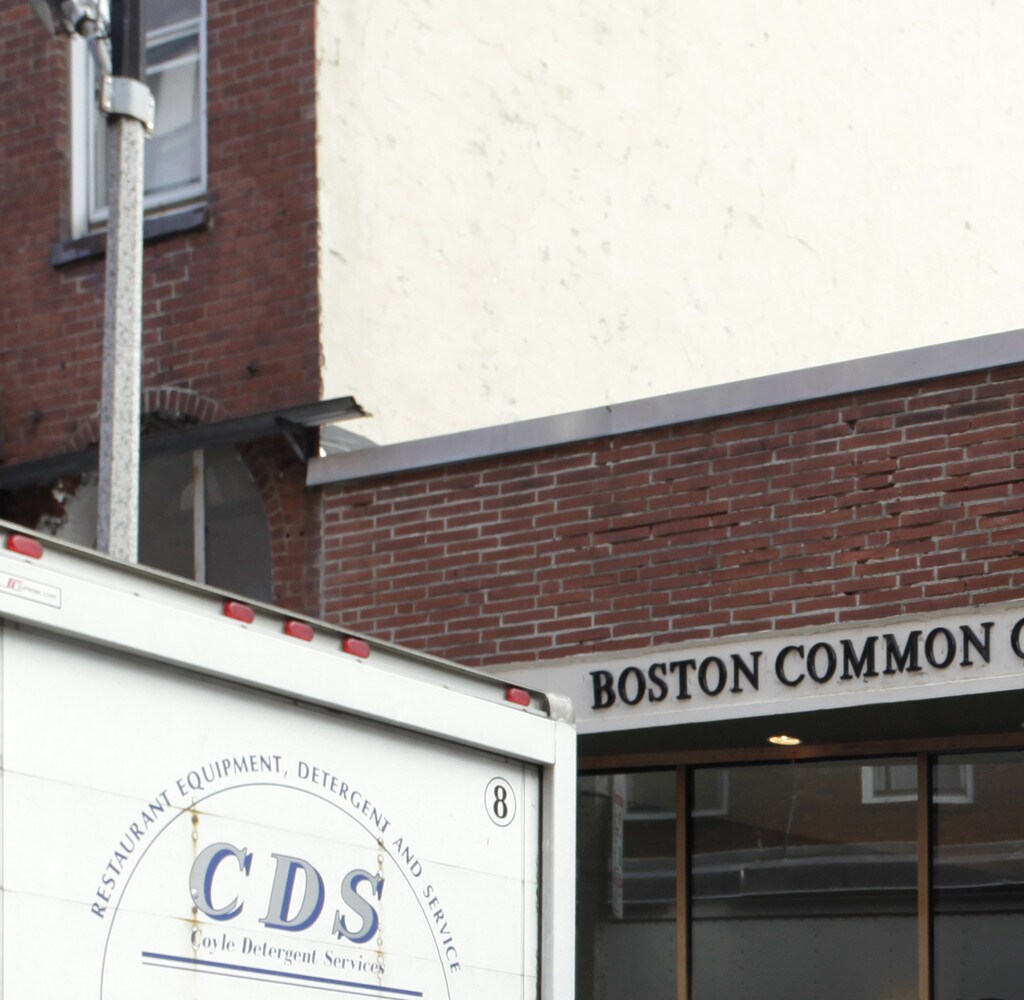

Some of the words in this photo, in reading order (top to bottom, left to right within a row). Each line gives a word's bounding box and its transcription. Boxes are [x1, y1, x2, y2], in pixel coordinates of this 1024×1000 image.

[590, 650, 760, 710] BOSTON
[774, 621, 994, 687] COMMON
[493, 785, 508, 819] 8
[91, 789, 173, 919] RESTAURANT
[176, 755, 288, 797] EQUIPMENT,
[297, 761, 391, 833] DETERGENT
[393, 837, 422, 878] AND
[423, 885, 461, 974] SERVICE
[189, 842, 385, 944] CDS
[191, 930, 236, 955] Coyle
[241, 937, 317, 966] Detergent
[323, 950, 386, 975] Services
